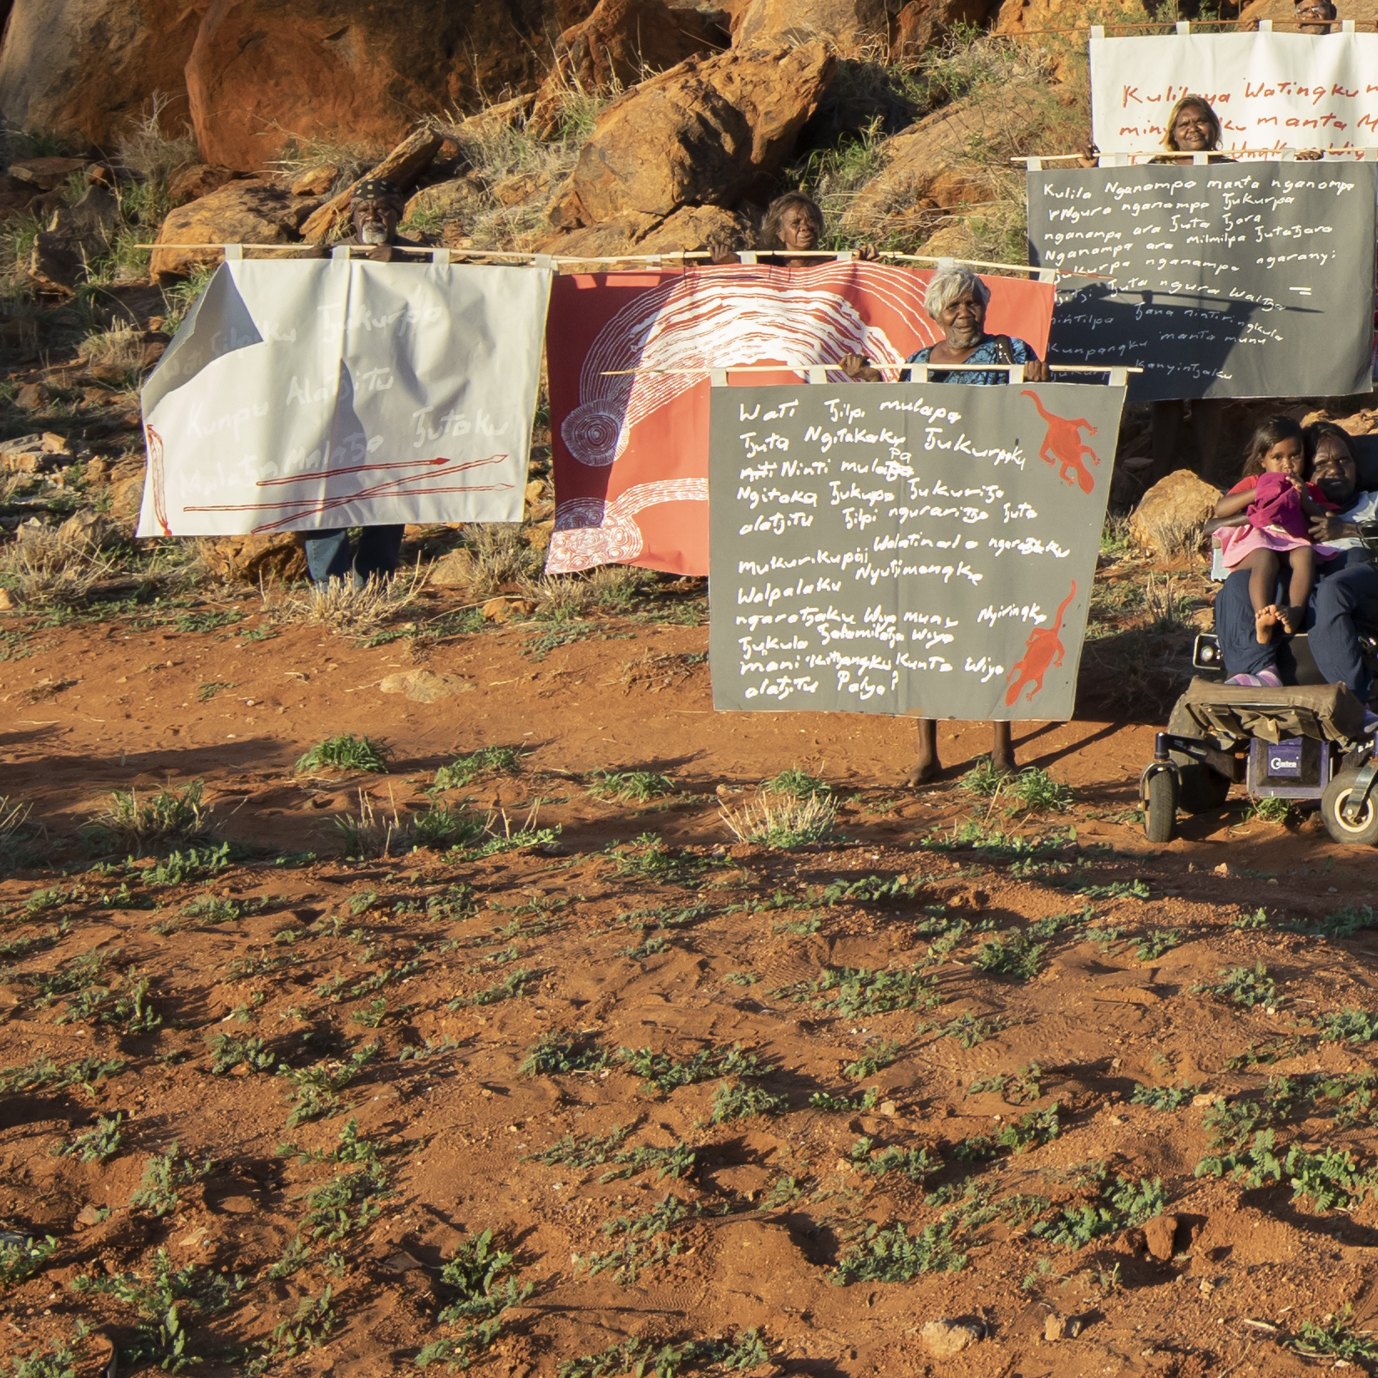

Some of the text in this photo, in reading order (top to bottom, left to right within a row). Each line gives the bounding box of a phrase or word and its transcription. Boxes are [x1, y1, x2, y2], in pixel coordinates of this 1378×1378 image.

[1123, 85, 1230, 107] Kulilya
[1044, 184, 1091, 199] Kulila
[1207, 175, 1260, 189] manta
[1044, 231, 1121, 245] nganampa
[1133, 225, 1161, 235] ara
[1045, 243, 1133, 266] Nganampa
[1146, 242, 1173, 250] ara
[1146, 258, 1240, 276] nganampa
[879, 398, 961, 424] mulapa
